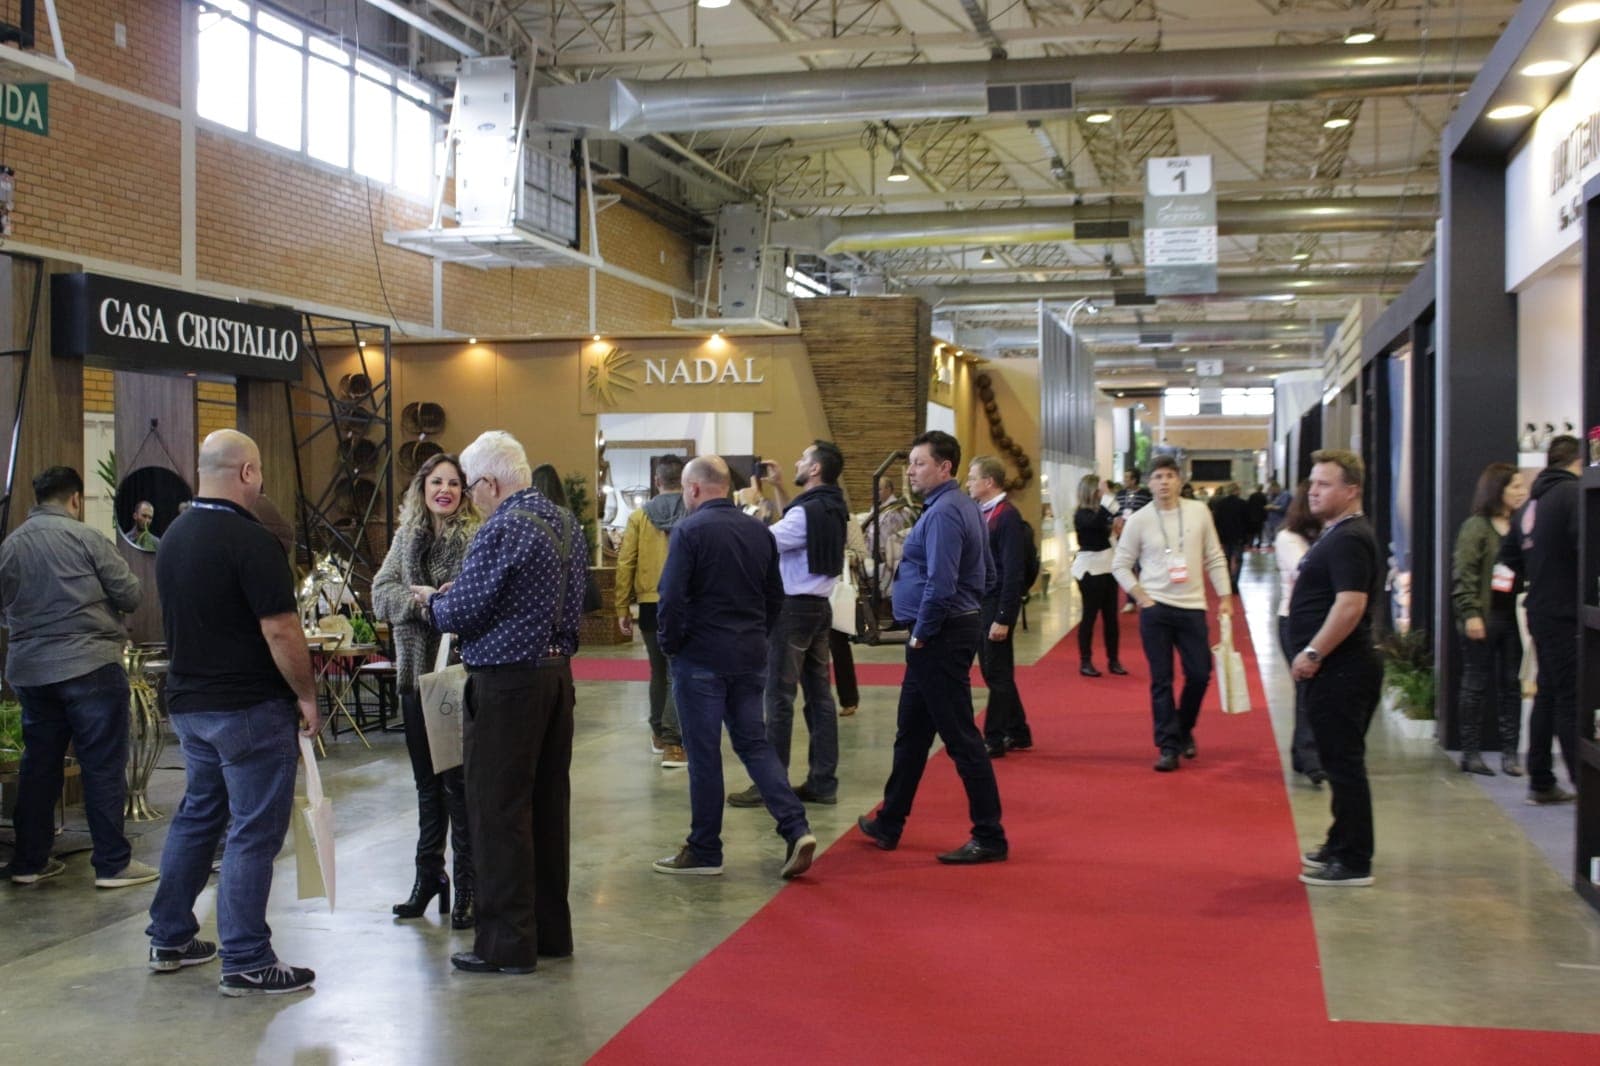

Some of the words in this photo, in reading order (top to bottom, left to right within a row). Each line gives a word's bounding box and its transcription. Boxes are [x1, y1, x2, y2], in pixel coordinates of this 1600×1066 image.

[0, 84, 44, 130] DA
[1173, 170, 1187, 193] 1
[100, 298, 169, 343] CASA
[177, 311, 298, 362] CRISTALLO
[643, 357, 764, 384] NADAL
